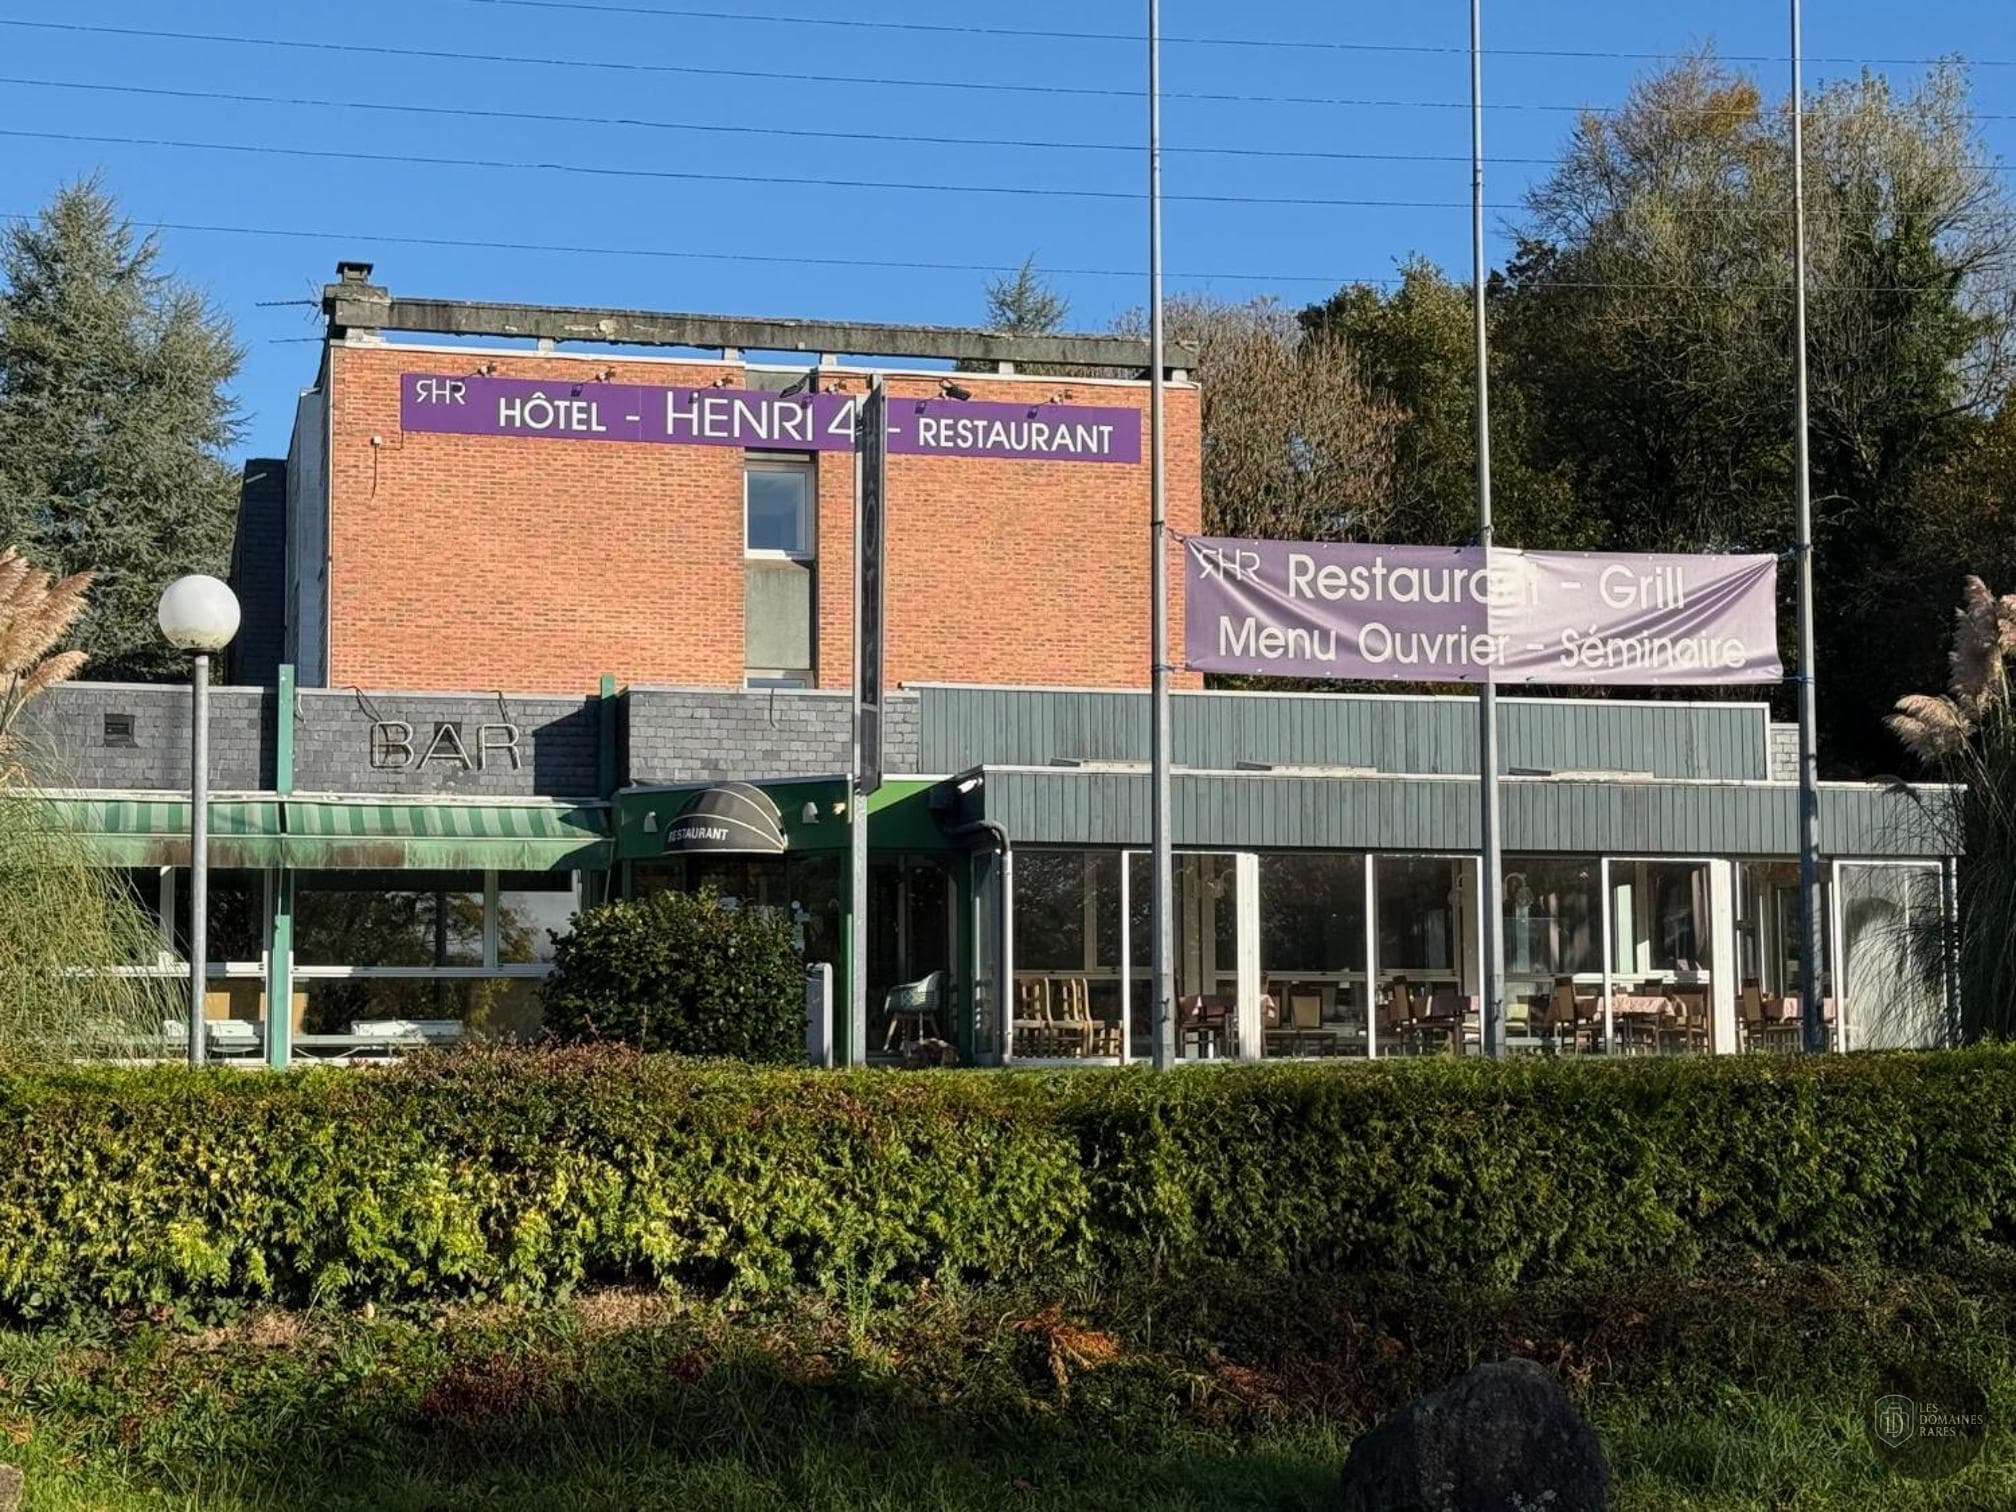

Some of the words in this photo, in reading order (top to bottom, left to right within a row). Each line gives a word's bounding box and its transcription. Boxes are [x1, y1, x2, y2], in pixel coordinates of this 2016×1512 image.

[499, 391, 607, 432] HÔTEL
[666, 391, 813, 441] HENRI
[827, 400, 856, 443] 4
[918, 417, 1114, 454] RESTAURANT
[1599, 564, 1686, 610] Grill
[1219, 616, 1337, 662] Menu
[1358, 621, 1510, 667] Ouvrier
[1560, 623, 1747, 669] Séminaire
[372, 721, 522, 770] BAR
[668, 827, 729, 842] RESTAURANT
